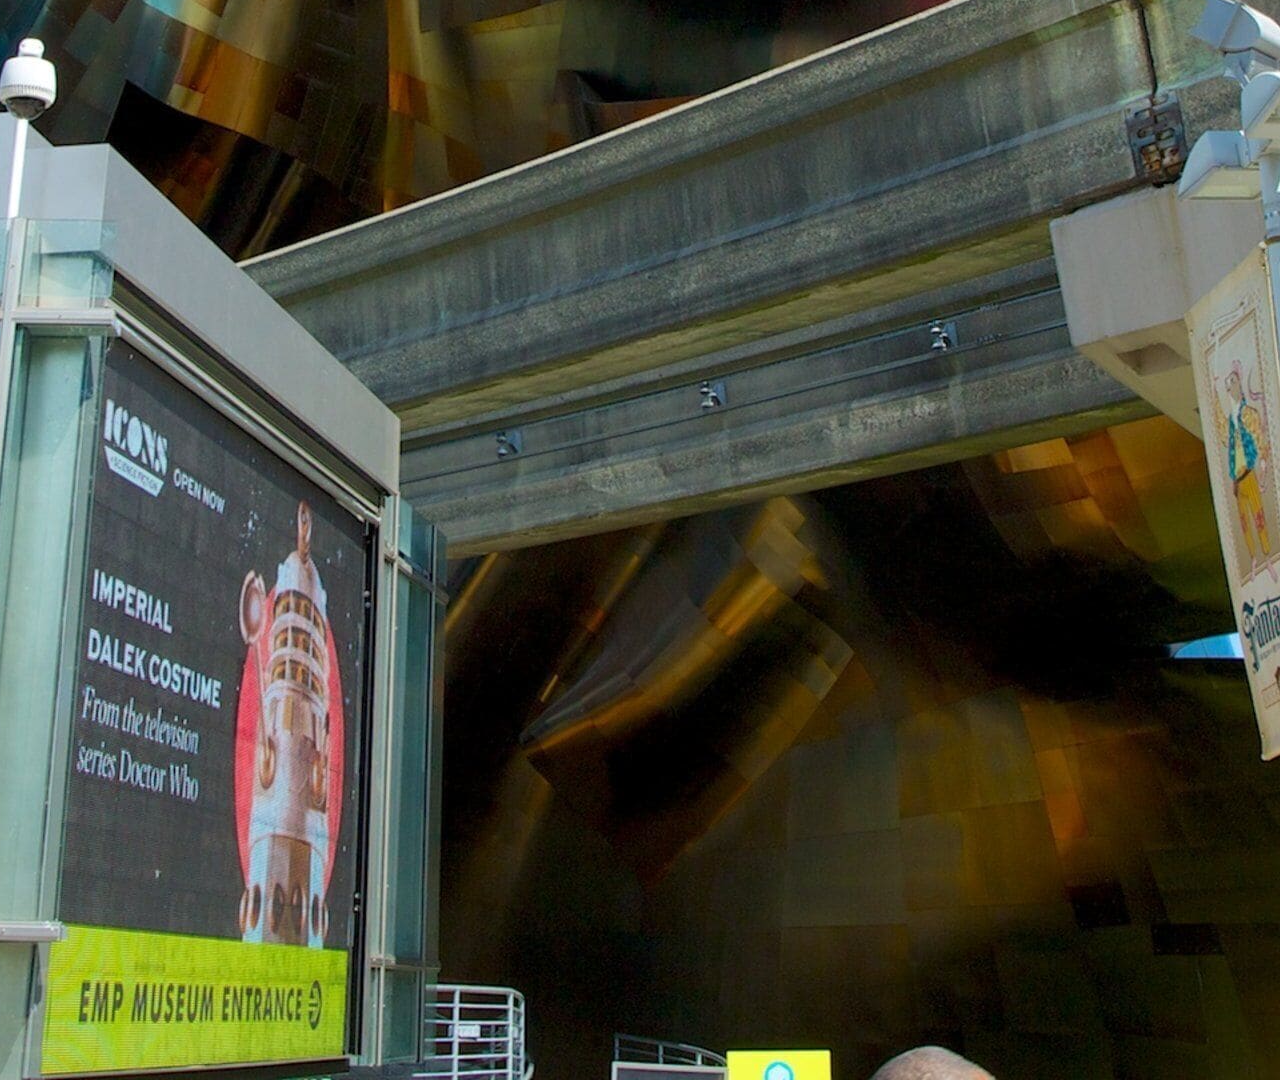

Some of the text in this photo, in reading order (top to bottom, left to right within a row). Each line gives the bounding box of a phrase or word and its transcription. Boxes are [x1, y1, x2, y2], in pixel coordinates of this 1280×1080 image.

[104, 399, 168, 476] ICONS
[173, 468, 226, 515] OPEN NOW
[91, 568, 173, 634] IMPERIAL
[86, 628, 222, 709] DALEK COSTUME
[81, 684, 199, 755] From the television
[76, 740, 199, 802] series Doctor Who
[78, 980, 304, 1024] EMP MUSEUM ENTRANCE
